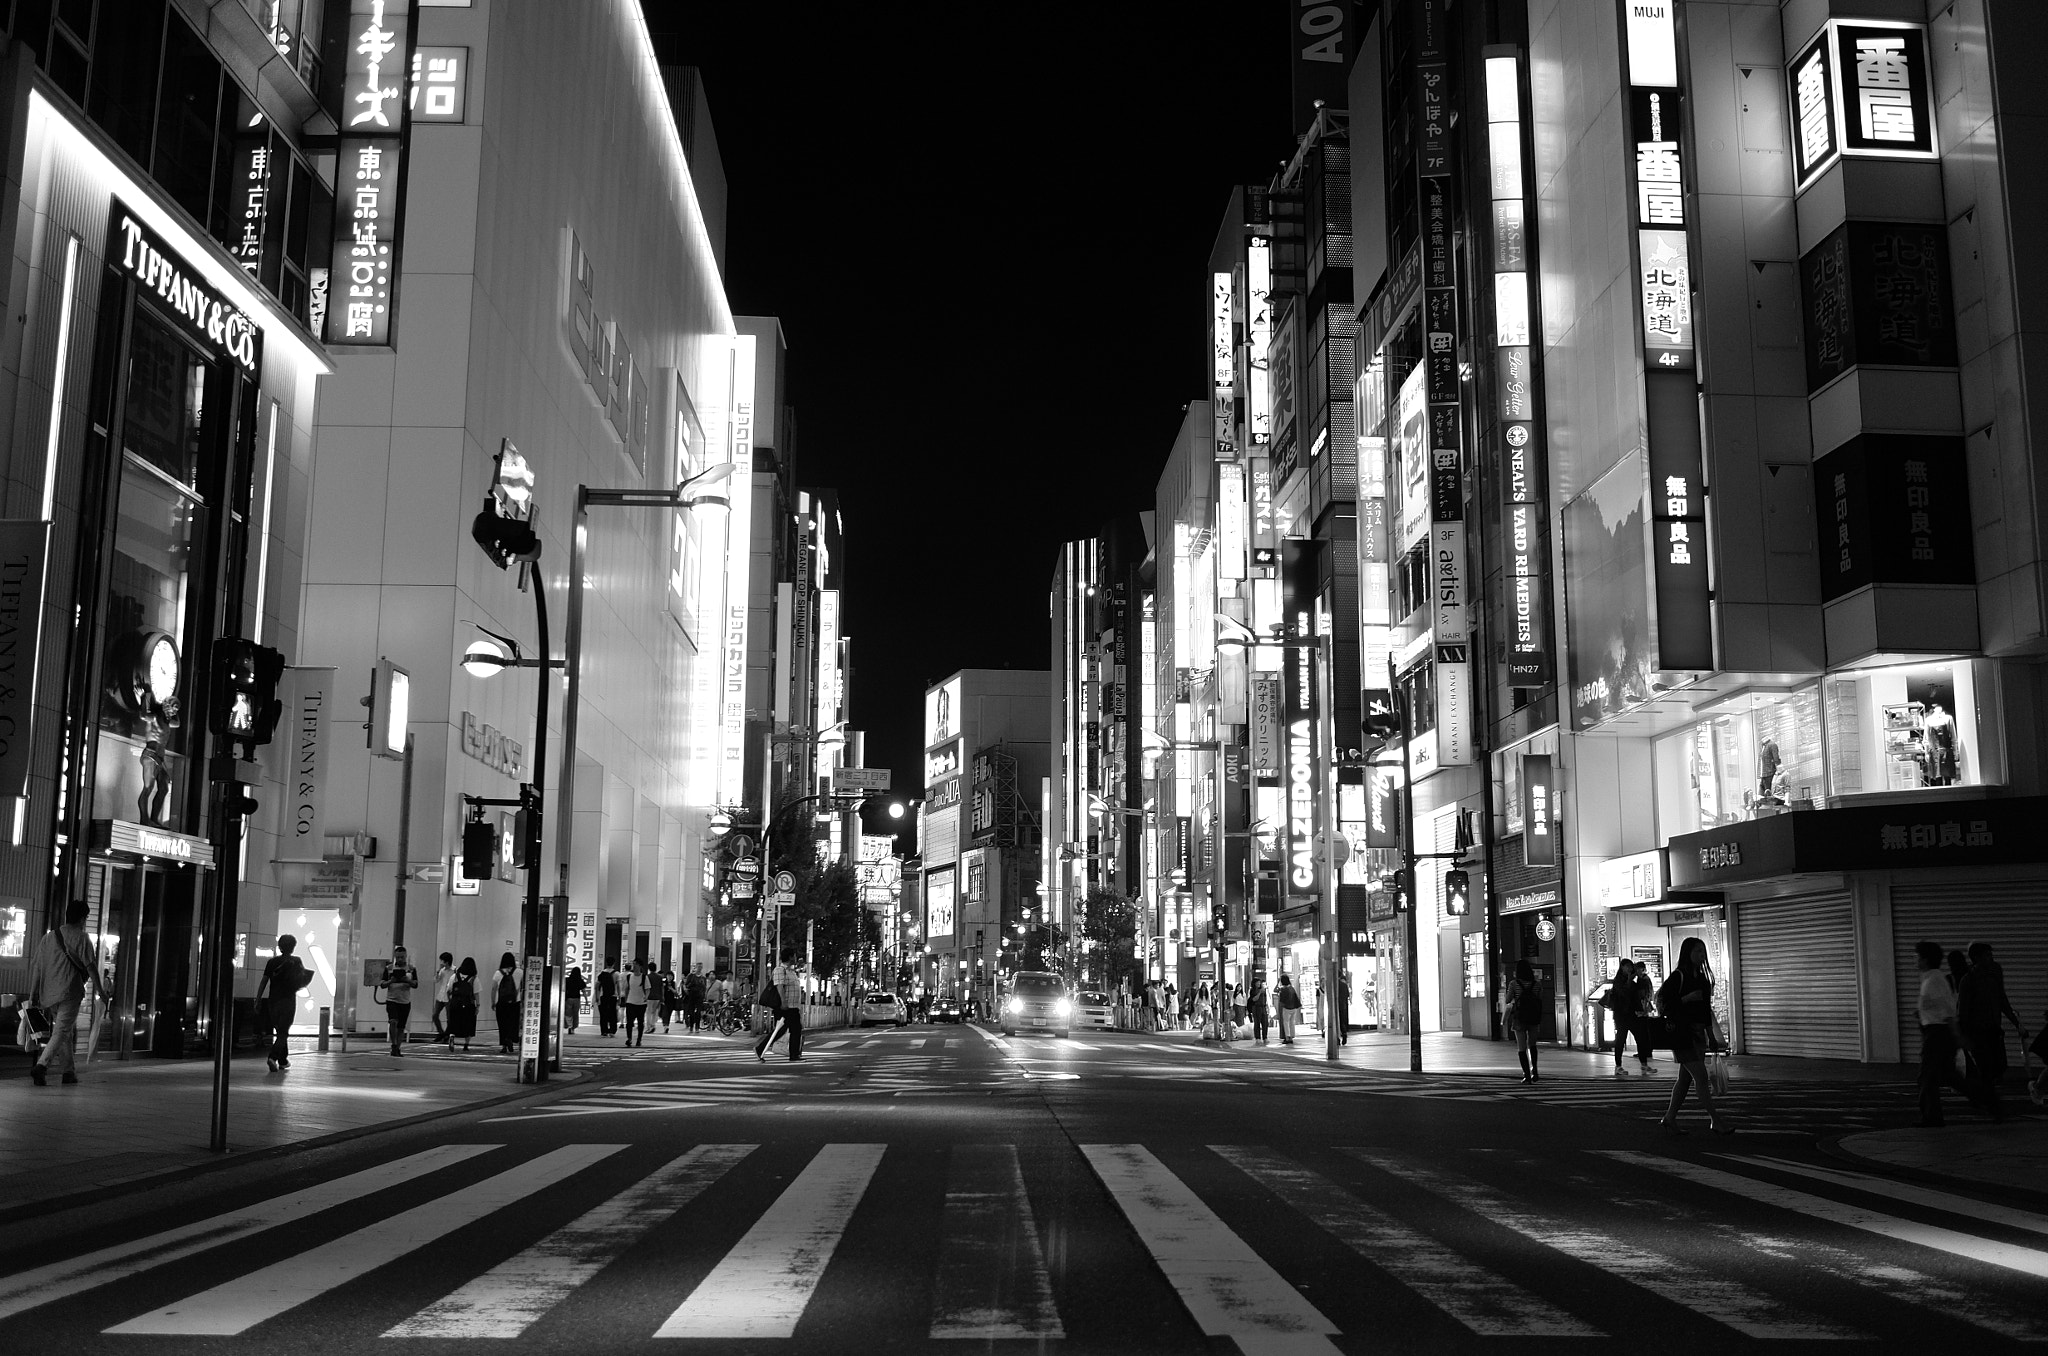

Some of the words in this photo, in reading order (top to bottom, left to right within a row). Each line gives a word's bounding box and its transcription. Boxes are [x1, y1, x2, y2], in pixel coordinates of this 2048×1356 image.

[1634, 6, 1664, 19] MUJI
[1423, 72, 1442, 138] なんぼや
[1797, 48, 1830, 171] 番屋
[1856, 37, 1916, 142] 番屋
[1427, 158, 1444, 168] 7F
[1637, 141, 1684, 224] 番屋
[1252, 238, 1266, 248] 9F
[1646, 268, 1681, 336] 北海道
[1812, 254, 1842, 366] 北海道
[1873, 236, 1928, 352] 北海道
[1218, 369, 1230, 377] 8F
[1659, 352, 1680, 366] 4F
[1506, 381, 1524, 416] Getter
[1220, 443, 1231, 451] 7F
[1361, 449, 1371, 495] イーオン
[1511, 448, 1524, 502] NEAL'S
[1255, 485, 1270, 535] ガスト
[1365, 502, 1374, 558] ビューティハウス
[1374, 502, 1382, 525] スリム
[1441, 510, 1453, 518] 5F
[1513, 507, 1527, 551] YARD
[1666, 476, 1691, 564] 無印良品
[1833, 472, 1852, 574] 無印良品
[1904, 458, 1936, 561] 無印良品
[797, 534, 807, 575] MEGANE
[1257, 551, 1271, 561] 4F
[1441, 531, 1455, 541] 3F
[797, 578, 807, 597] TOP
[1515, 554, 1531, 642] REMEDIES
[797, 599, 807, 648] SHINJUKU
[1441, 632, 1460, 640] HAIR
[730, 605, 745, 693] ビックカメラ
[1439, 648, 1464, 662] AX
[1116, 694, 1125, 715] Pausa
[1299, 667, 1309, 710] ITALIAN
[302, 690, 322, 780] TIFFANY
[1257, 682, 1268, 767] みずのクリニック
[836, 770, 889, 780] 新宿三丁目西
[972, 755, 992, 786] 洋服の
[1227, 754, 1238, 783] AOKI
[299, 783, 310, 796] &
[972, 787, 992, 832] 青山
[1291, 719, 1314, 888] CALZEDONIA
[1532, 785, 1548, 835] 無印良品
[296, 803, 315, 838] CO.
[1881, 820, 1994, 851] 無印良品
[863, 839, 890, 857] カラオケ
[1699, 842, 1742, 870] 無印良品
[567, 912, 578, 938] BIC
